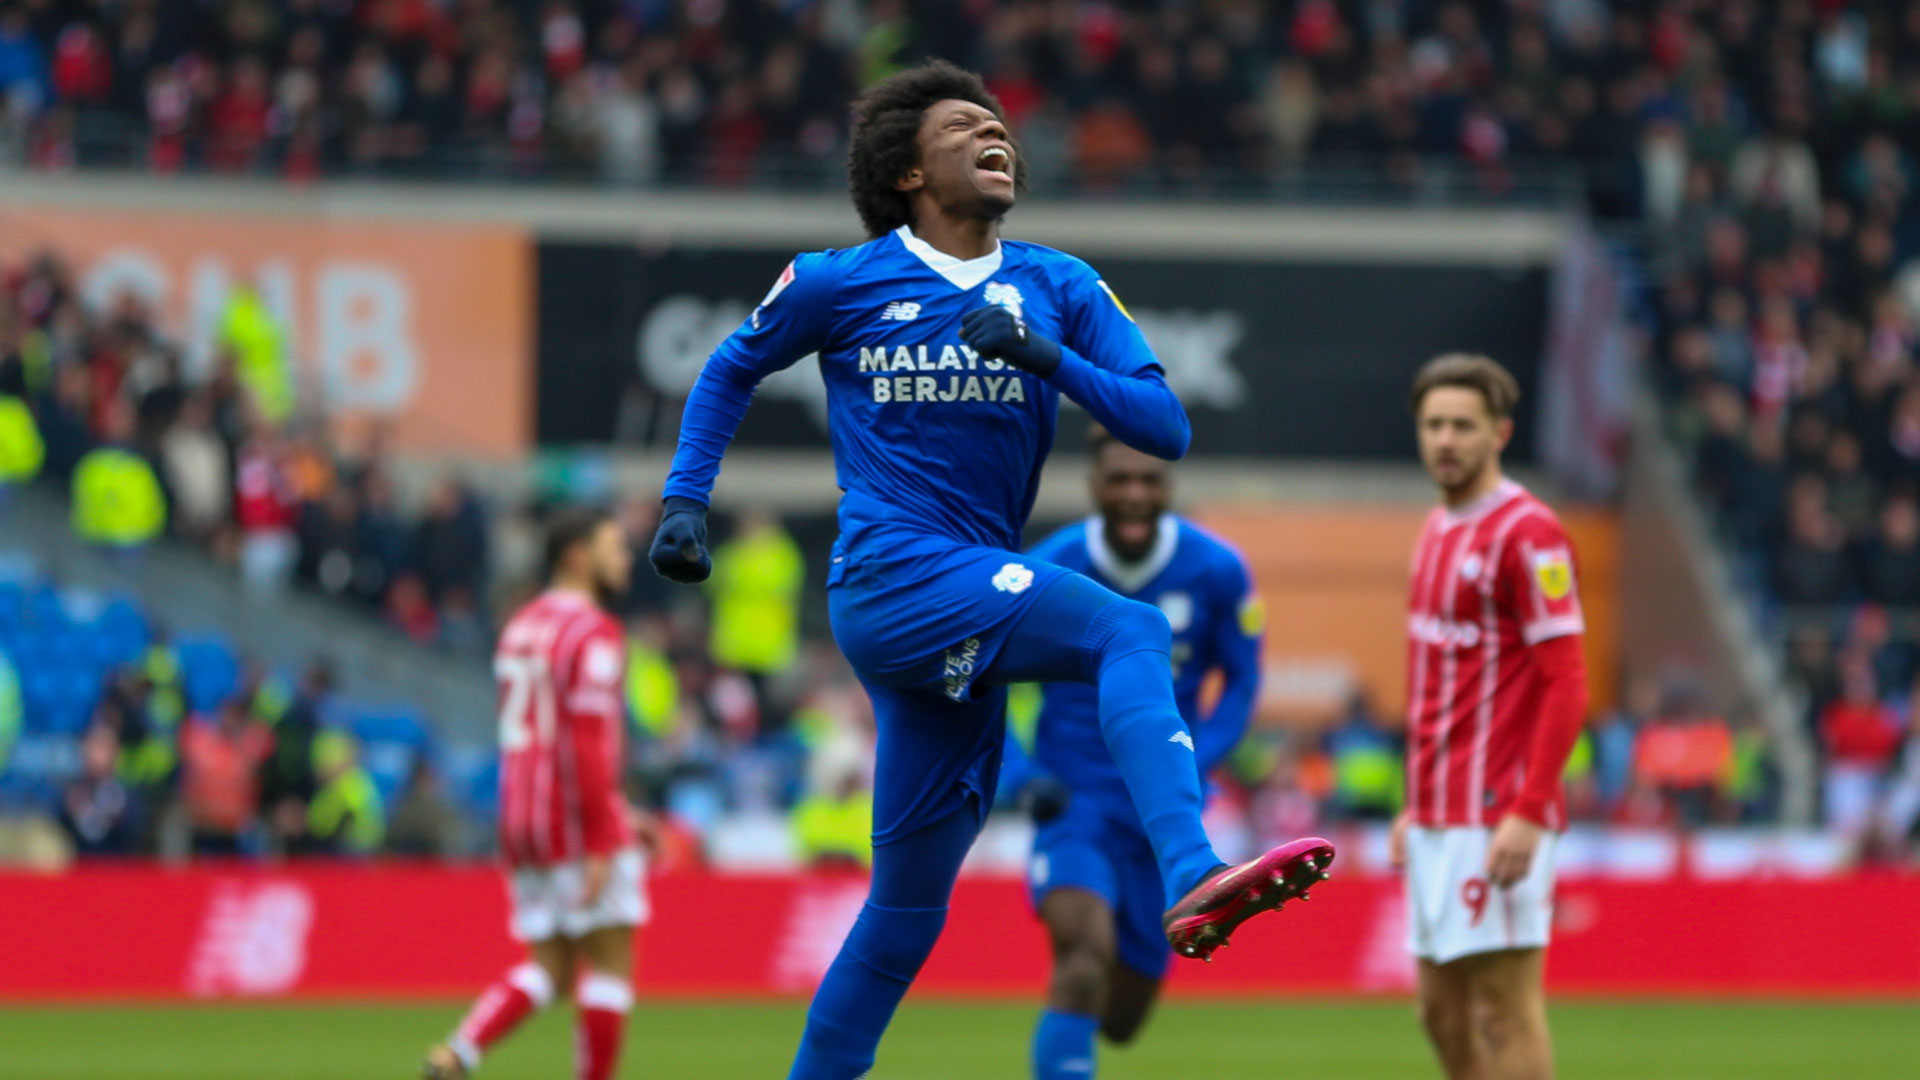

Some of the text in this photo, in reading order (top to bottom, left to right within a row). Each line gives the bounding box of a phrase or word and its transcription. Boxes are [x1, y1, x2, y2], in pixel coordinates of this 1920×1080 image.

[881, 301, 922, 320] NB
[858, 344, 1024, 373] MALAYS
[873, 376, 1025, 402] BERJAYA
[495, 656, 554, 749] 21
[1462, 878, 1490, 929] 9
